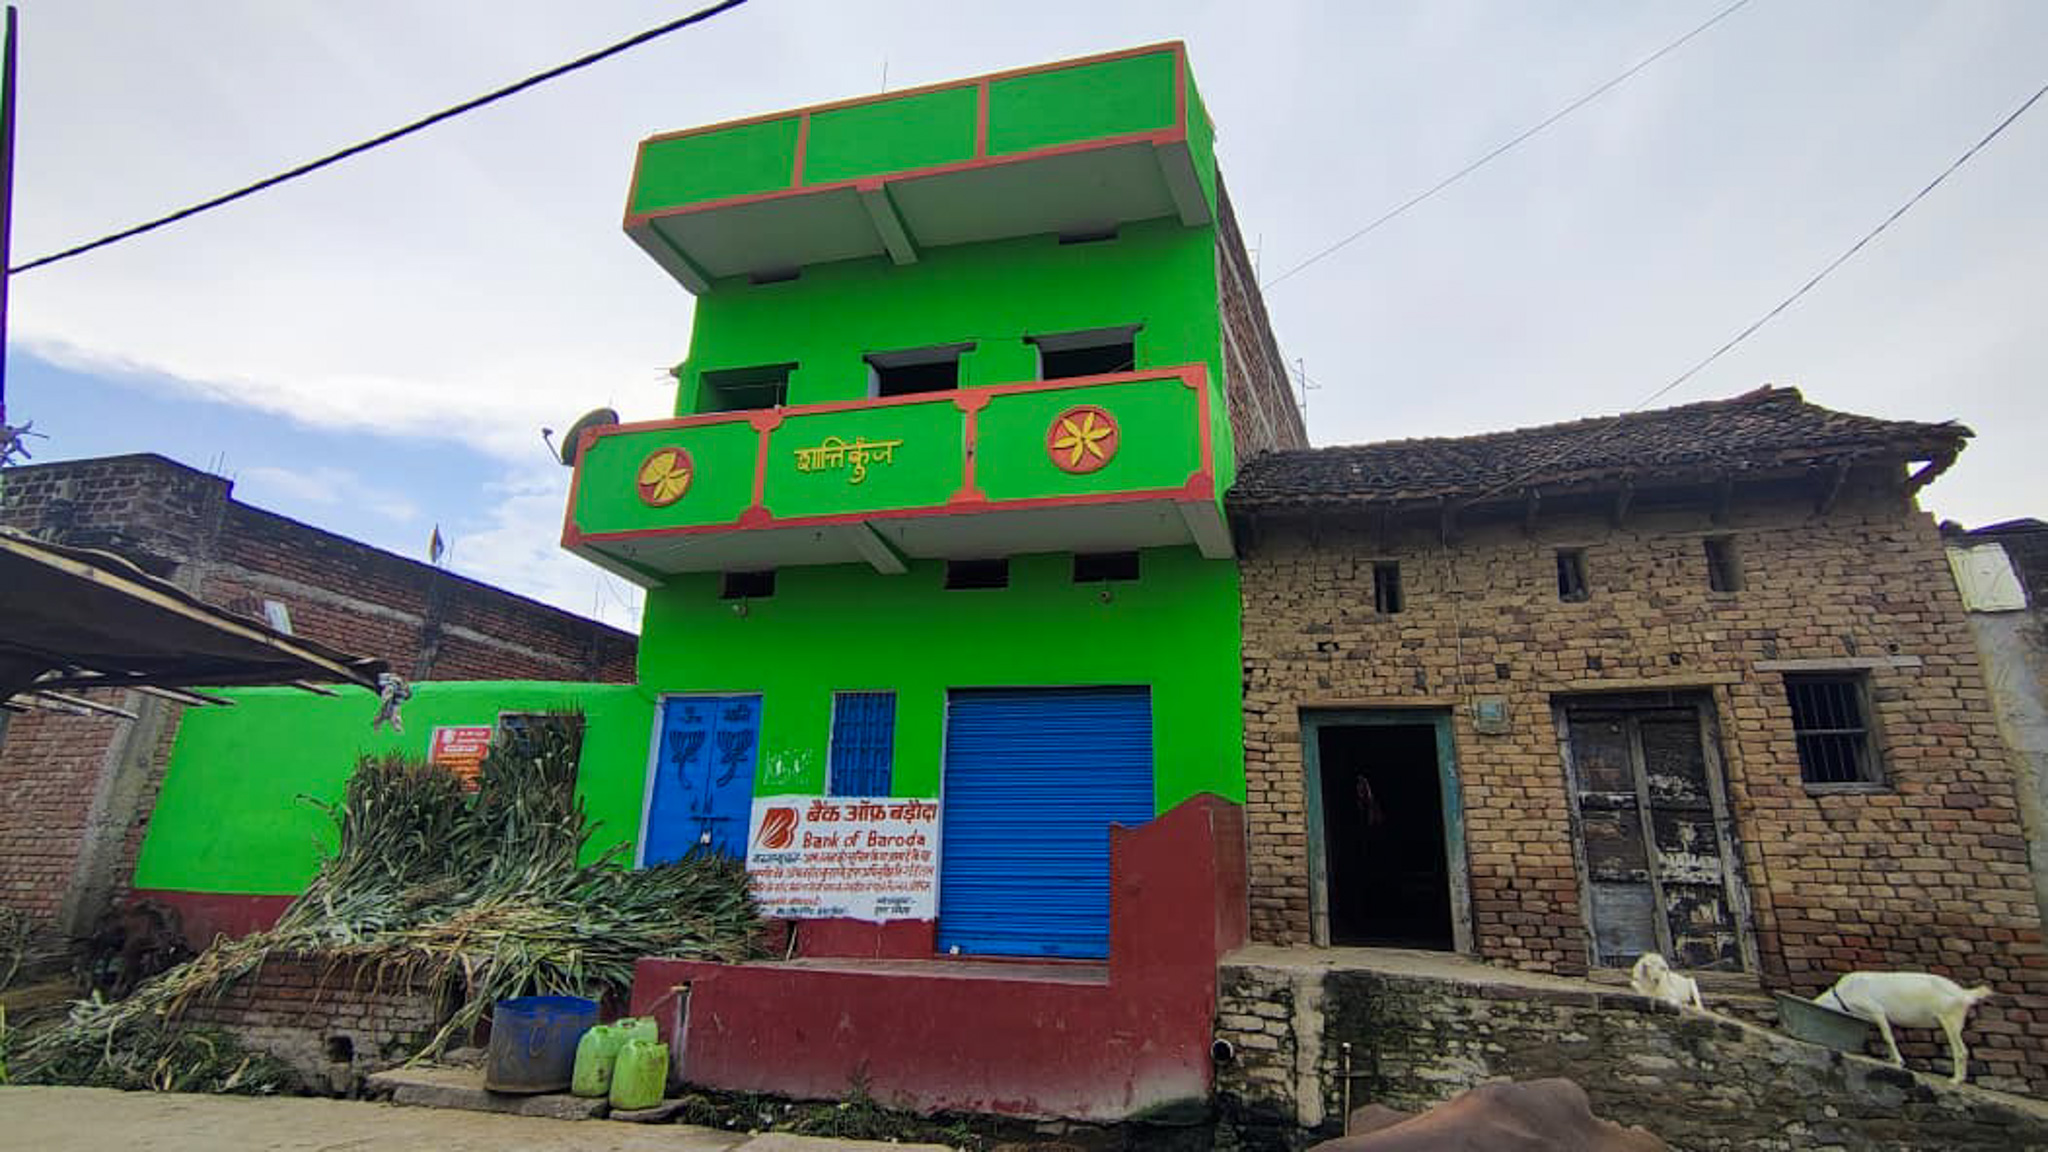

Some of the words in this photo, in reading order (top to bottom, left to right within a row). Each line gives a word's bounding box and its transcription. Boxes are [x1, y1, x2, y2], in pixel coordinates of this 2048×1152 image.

[806, 799, 840, 822] बैंक
[802, 831, 839, 848] Bank
[844, 831, 863, 847] of
[867, 829, 926, 847] Baroda
